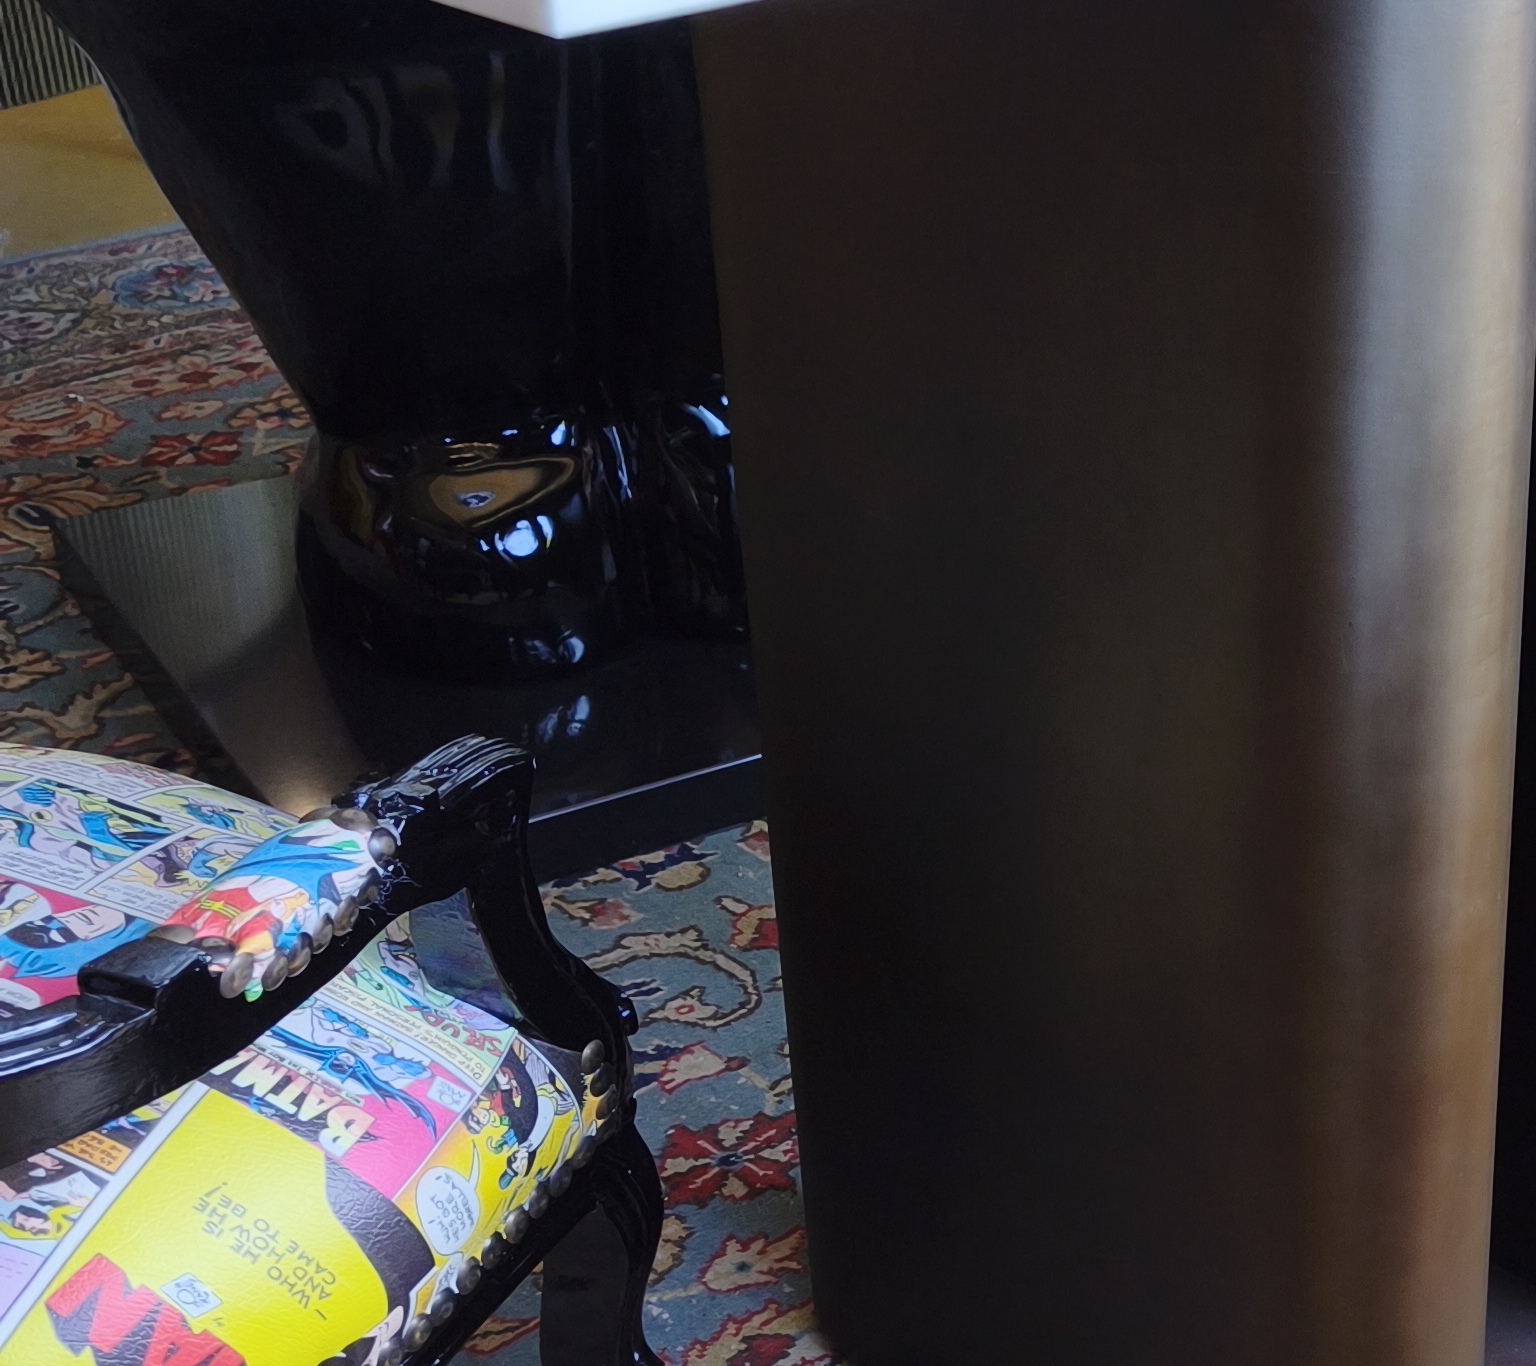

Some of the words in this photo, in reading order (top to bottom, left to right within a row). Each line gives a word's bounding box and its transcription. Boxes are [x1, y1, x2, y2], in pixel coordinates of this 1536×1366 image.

[192, 1196, 227, 1223] HE
[204, 1182, 246, 1217] BE!
[429, 1194, 450, 1218] GOT
[201, 1219, 223, 1237] IS
[253, 1218, 277, 1243] TO
[228, 1237, 259, 1264] HE
[229, 1224, 284, 1263] HOW
[284, 1239, 336, 1283] CAME
[293, 1266, 331, 1300] AND
